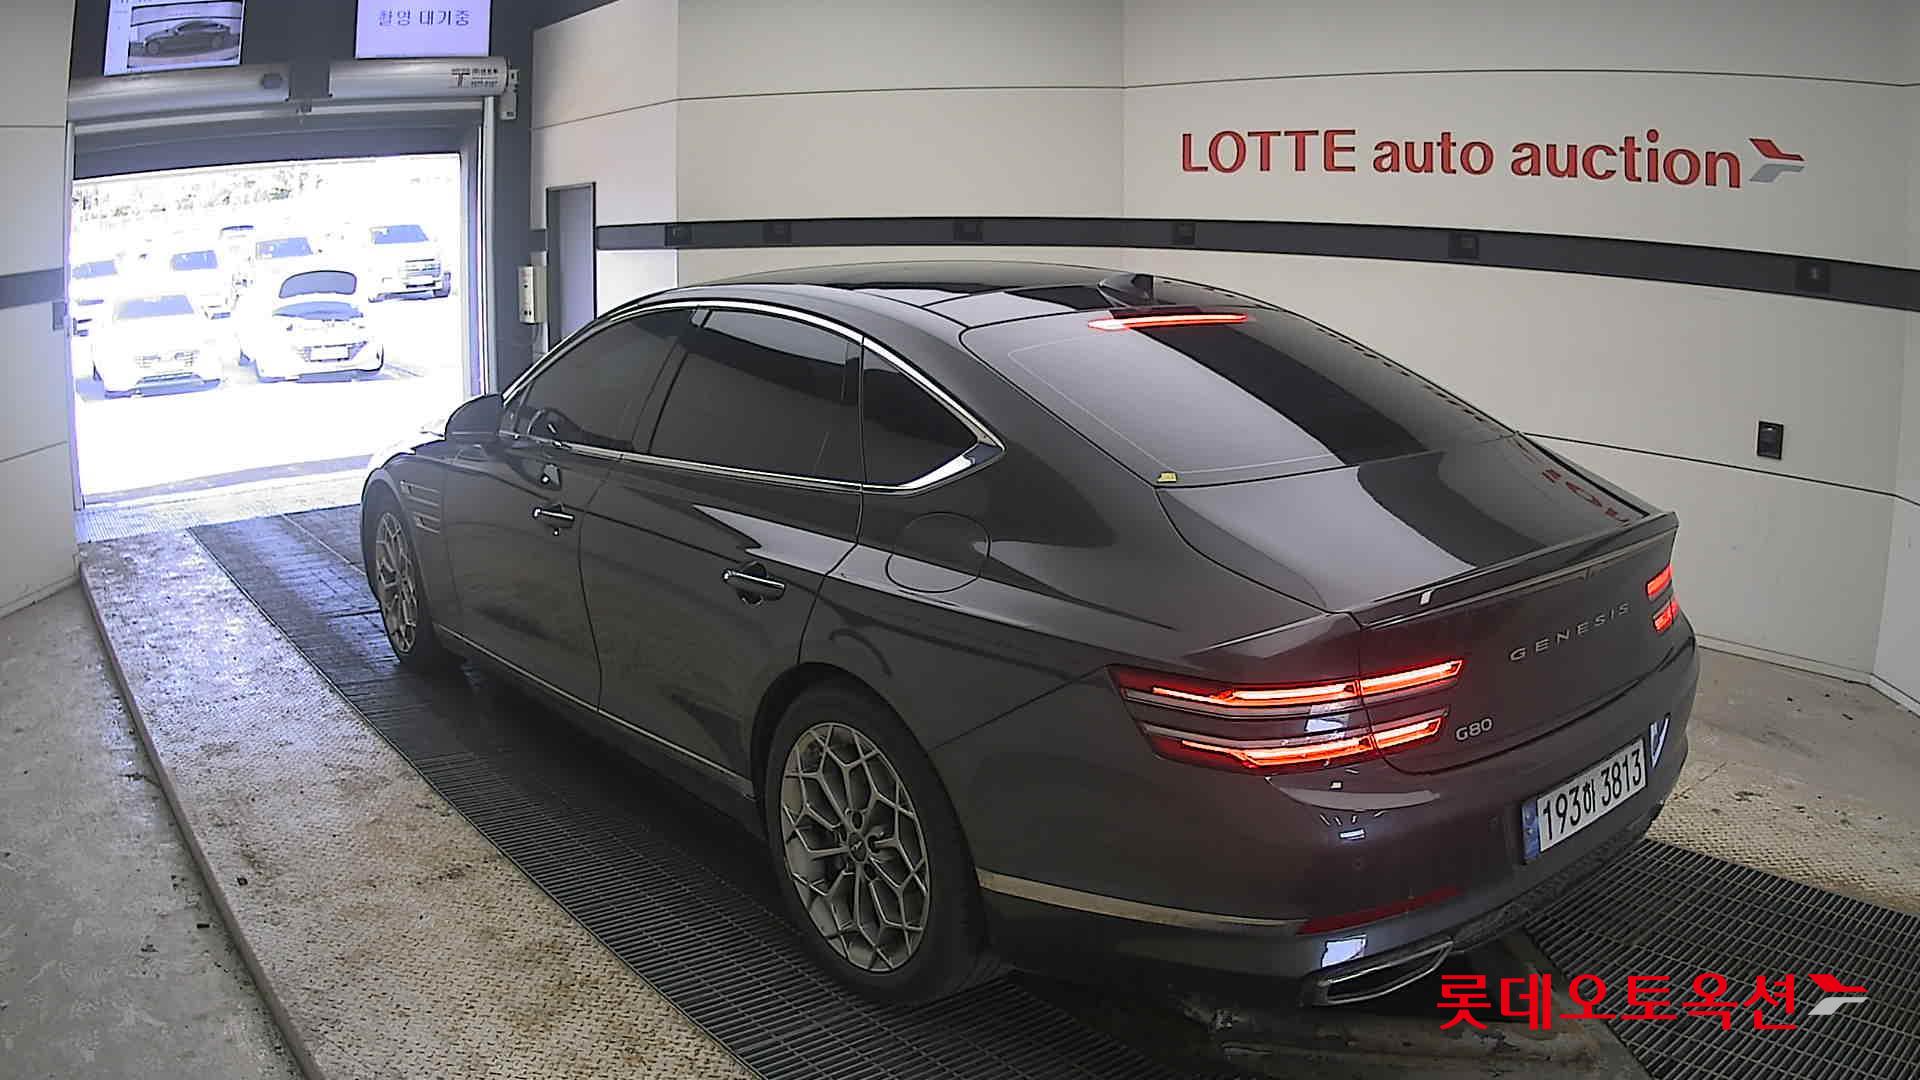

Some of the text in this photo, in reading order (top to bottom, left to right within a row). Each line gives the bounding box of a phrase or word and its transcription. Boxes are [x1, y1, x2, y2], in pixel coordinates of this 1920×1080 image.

[419, 9, 471, 26] 대기중
[1180, 129, 1741, 187] LOTTE auto auction
[1510, 602, 1629, 661] GENESIS
[1455, 718, 1493, 742] G80
[1542, 748, 1642, 841] 193하 3813
